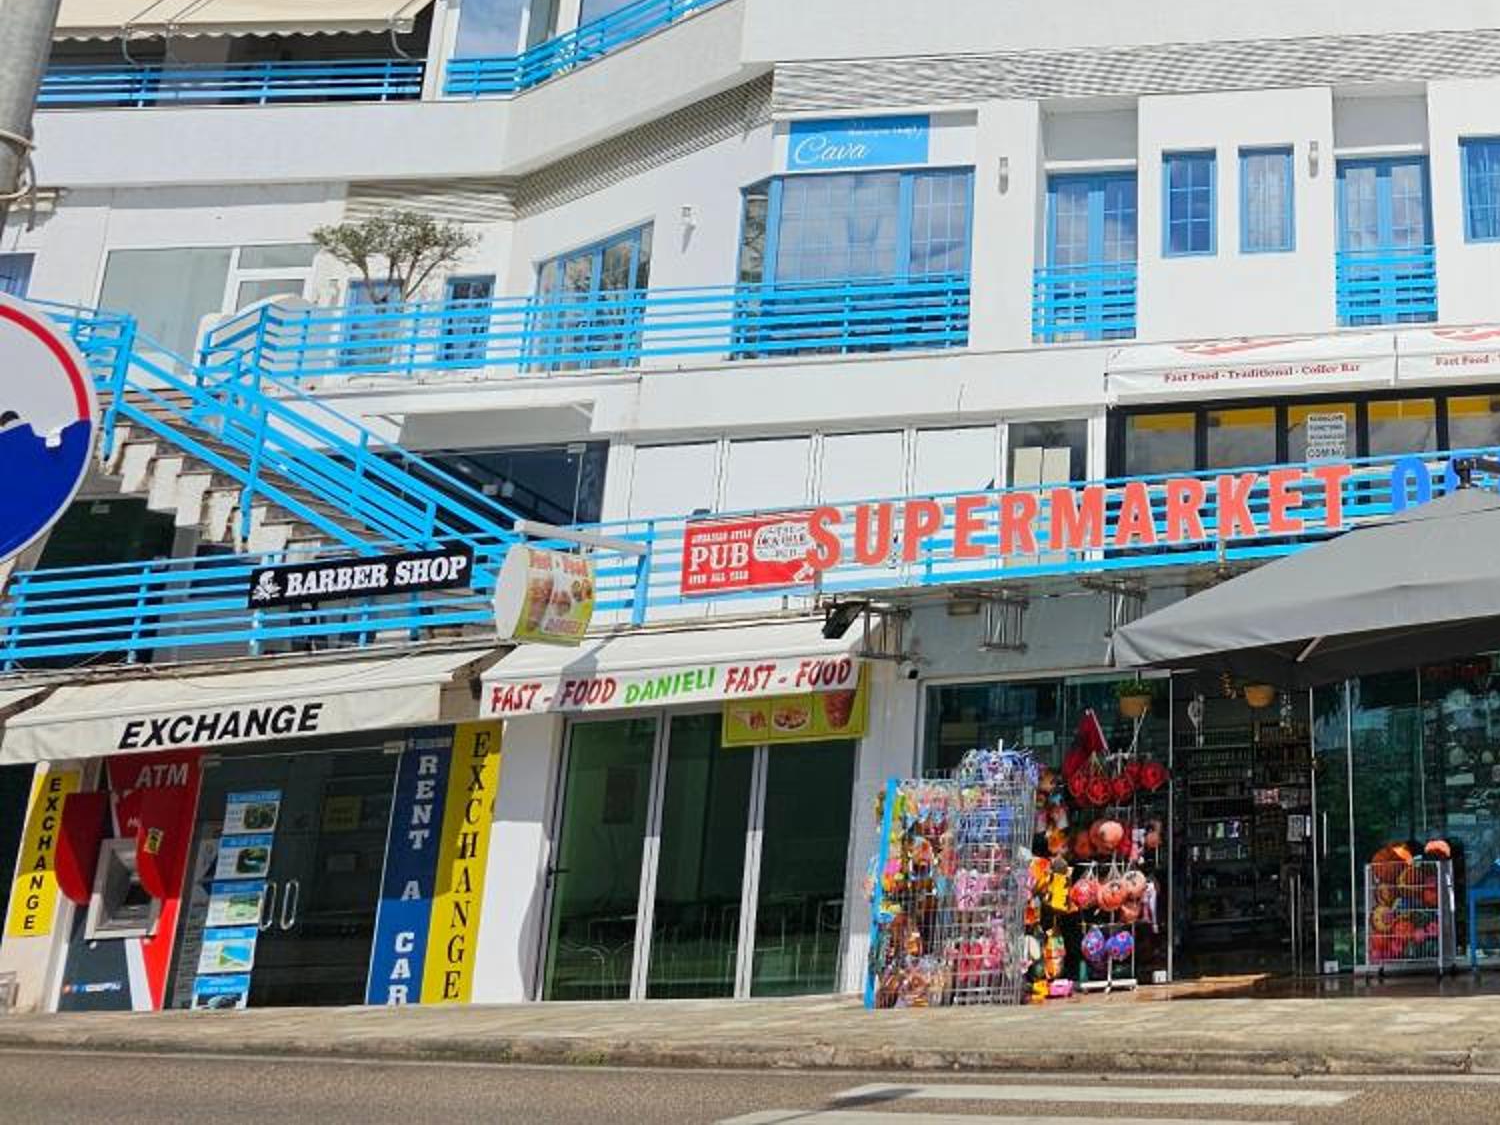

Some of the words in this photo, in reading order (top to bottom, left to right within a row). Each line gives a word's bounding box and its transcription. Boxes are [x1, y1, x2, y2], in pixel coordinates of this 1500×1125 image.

[795, 135, 869, 164] Cava
[1163, 373, 1188, 383] Fast
[1191, 371, 1219, 382] Food
[1227, 366, 1293, 380] Traditional
[1301, 363, 1337, 375] Coffee
[1341, 362, 1361, 373] Bar
[1435, 356, 1459, 366] Fast
[1462, 354, 1489, 365] Food
[806, 464, 1353, 570] SUPERMARKET
[285, 563, 389, 597] BARBER
[393, 555, 467, 586] SHOP
[688, 542, 749, 572] PUB
[491, 682, 541, 712] FAST
[559, 677, 617, 707] FOOD
[625, 666, 716, 704] DANIELI
[723, 664, 777, 693] FAST
[795, 657, 852, 688] FOOD
[118, 702, 324, 750] EXCHANGE
[135, 762, 189, 788] ATM
[409, 755, 439, 850] RENT
[23, 777, 62, 930] EXCHANGE
[441, 731, 491, 1000] EXCHANGE
[401, 880, 421, 900] A
[387, 931, 415, 1004] CAR
